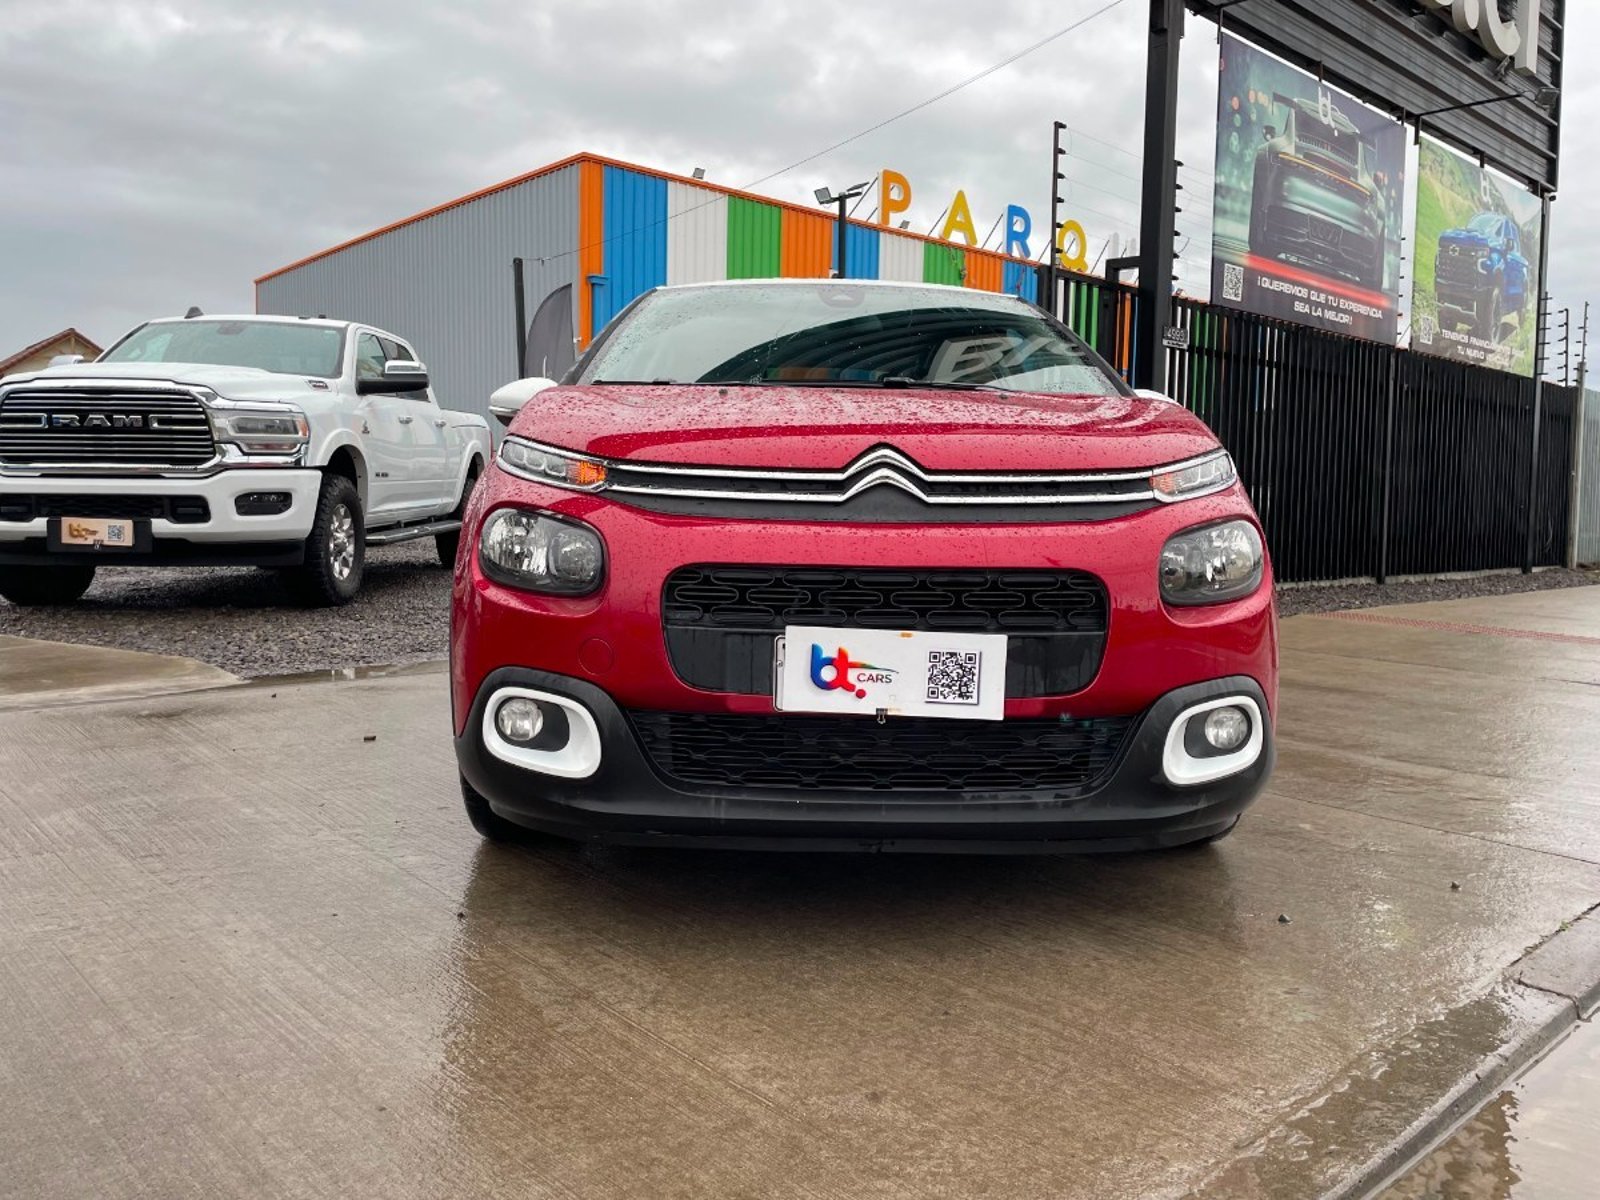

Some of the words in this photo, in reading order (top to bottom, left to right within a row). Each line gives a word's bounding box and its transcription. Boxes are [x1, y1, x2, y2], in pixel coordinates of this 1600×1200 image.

[1310, 290, 1326, 303] QUE
[1327, 296, 1338, 307] TU
[1294, 301, 1310, 314] SEA
[1311, 306, 1322, 317] LA
[52, 414, 142, 427] RAM
[857, 672, 893, 684] CARS
